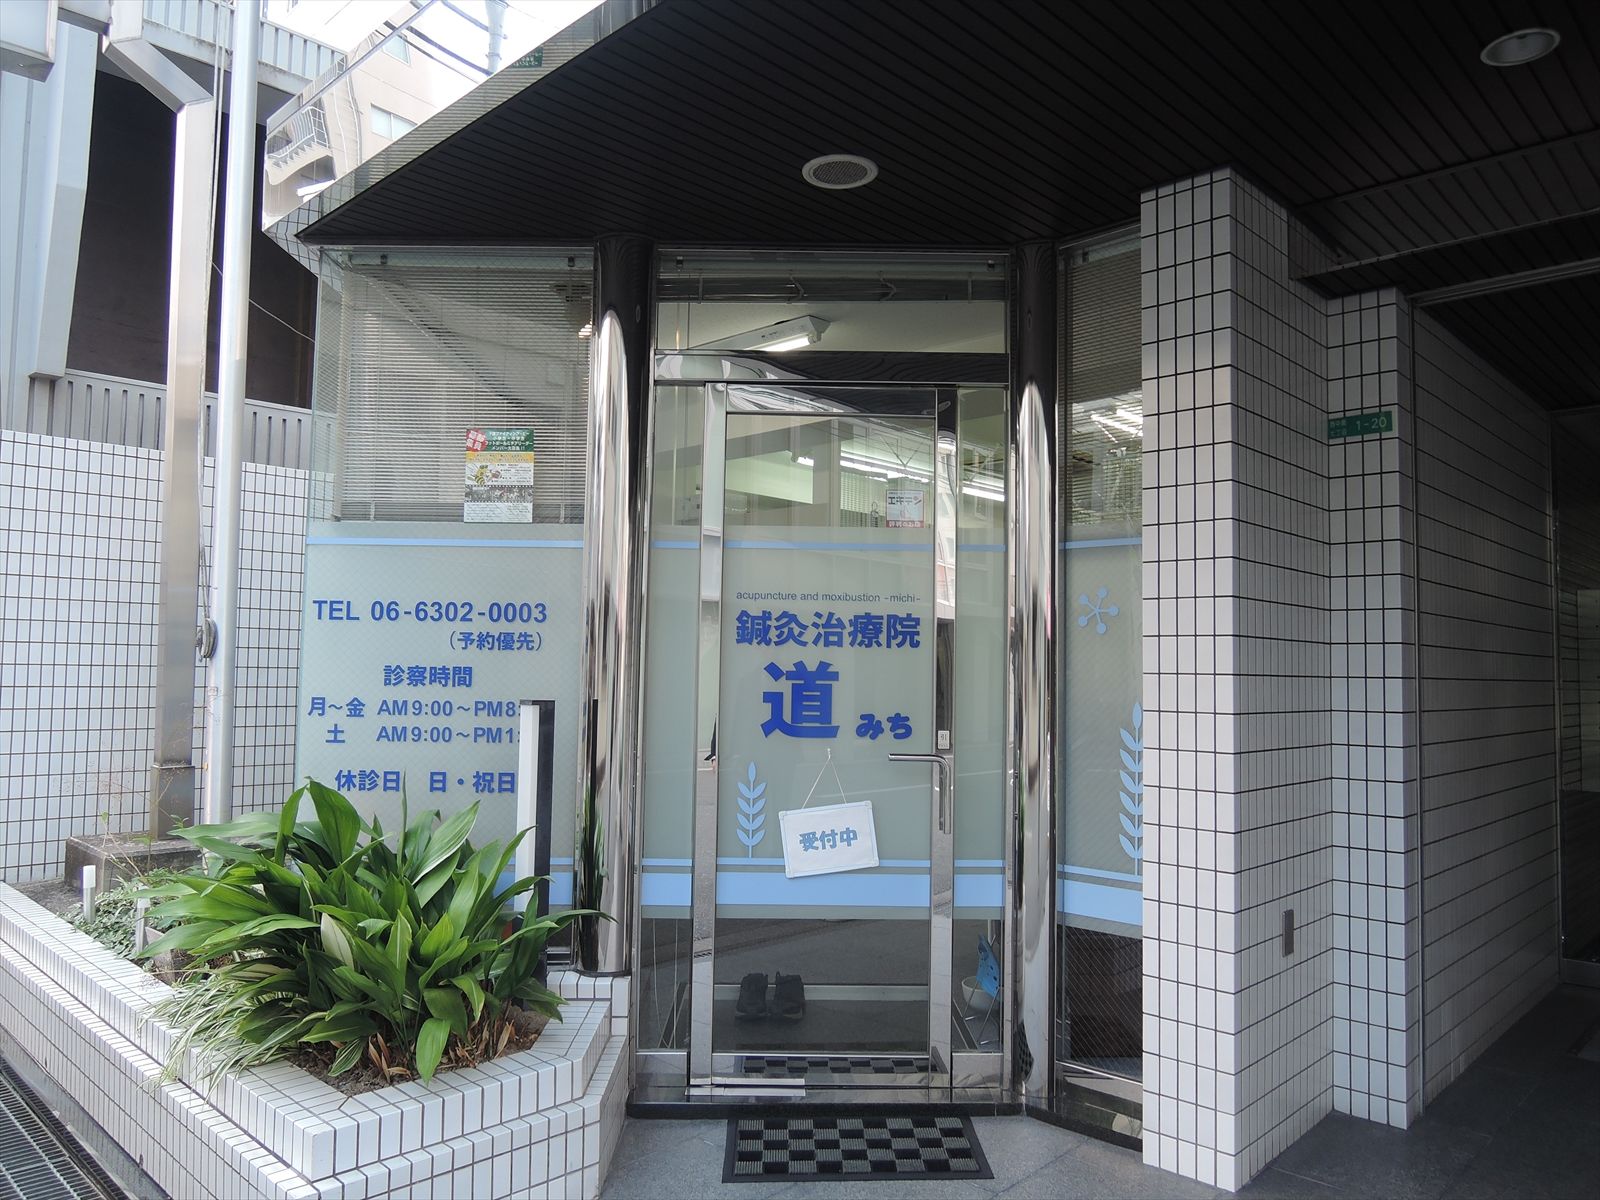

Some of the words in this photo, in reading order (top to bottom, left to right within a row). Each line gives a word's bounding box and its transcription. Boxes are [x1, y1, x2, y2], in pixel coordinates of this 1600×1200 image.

[1356, 416, 1387, 431] 1-20
[736, 591, 797, 601] acupuncture
[800, 591, 819, 600] and
[821, 592, 881, 602] moxibustion
[884, 592, 921, 603] -michi-
[312, 600, 360, 621] TEL
[370, 600, 548, 624] 06-6302-0003
[735, 610, 921, 649] 鍼灸治療院
[383, 664, 473, 688] 診察時間
[760, 660, 840, 739] 道
[855, 713, 913, 740] みち
[325, 723, 346, 744] 土
[334, 769, 401, 793] 休診日
[428, 770, 516, 794] 日・祝日
[799, 827, 858, 852] 受付中
